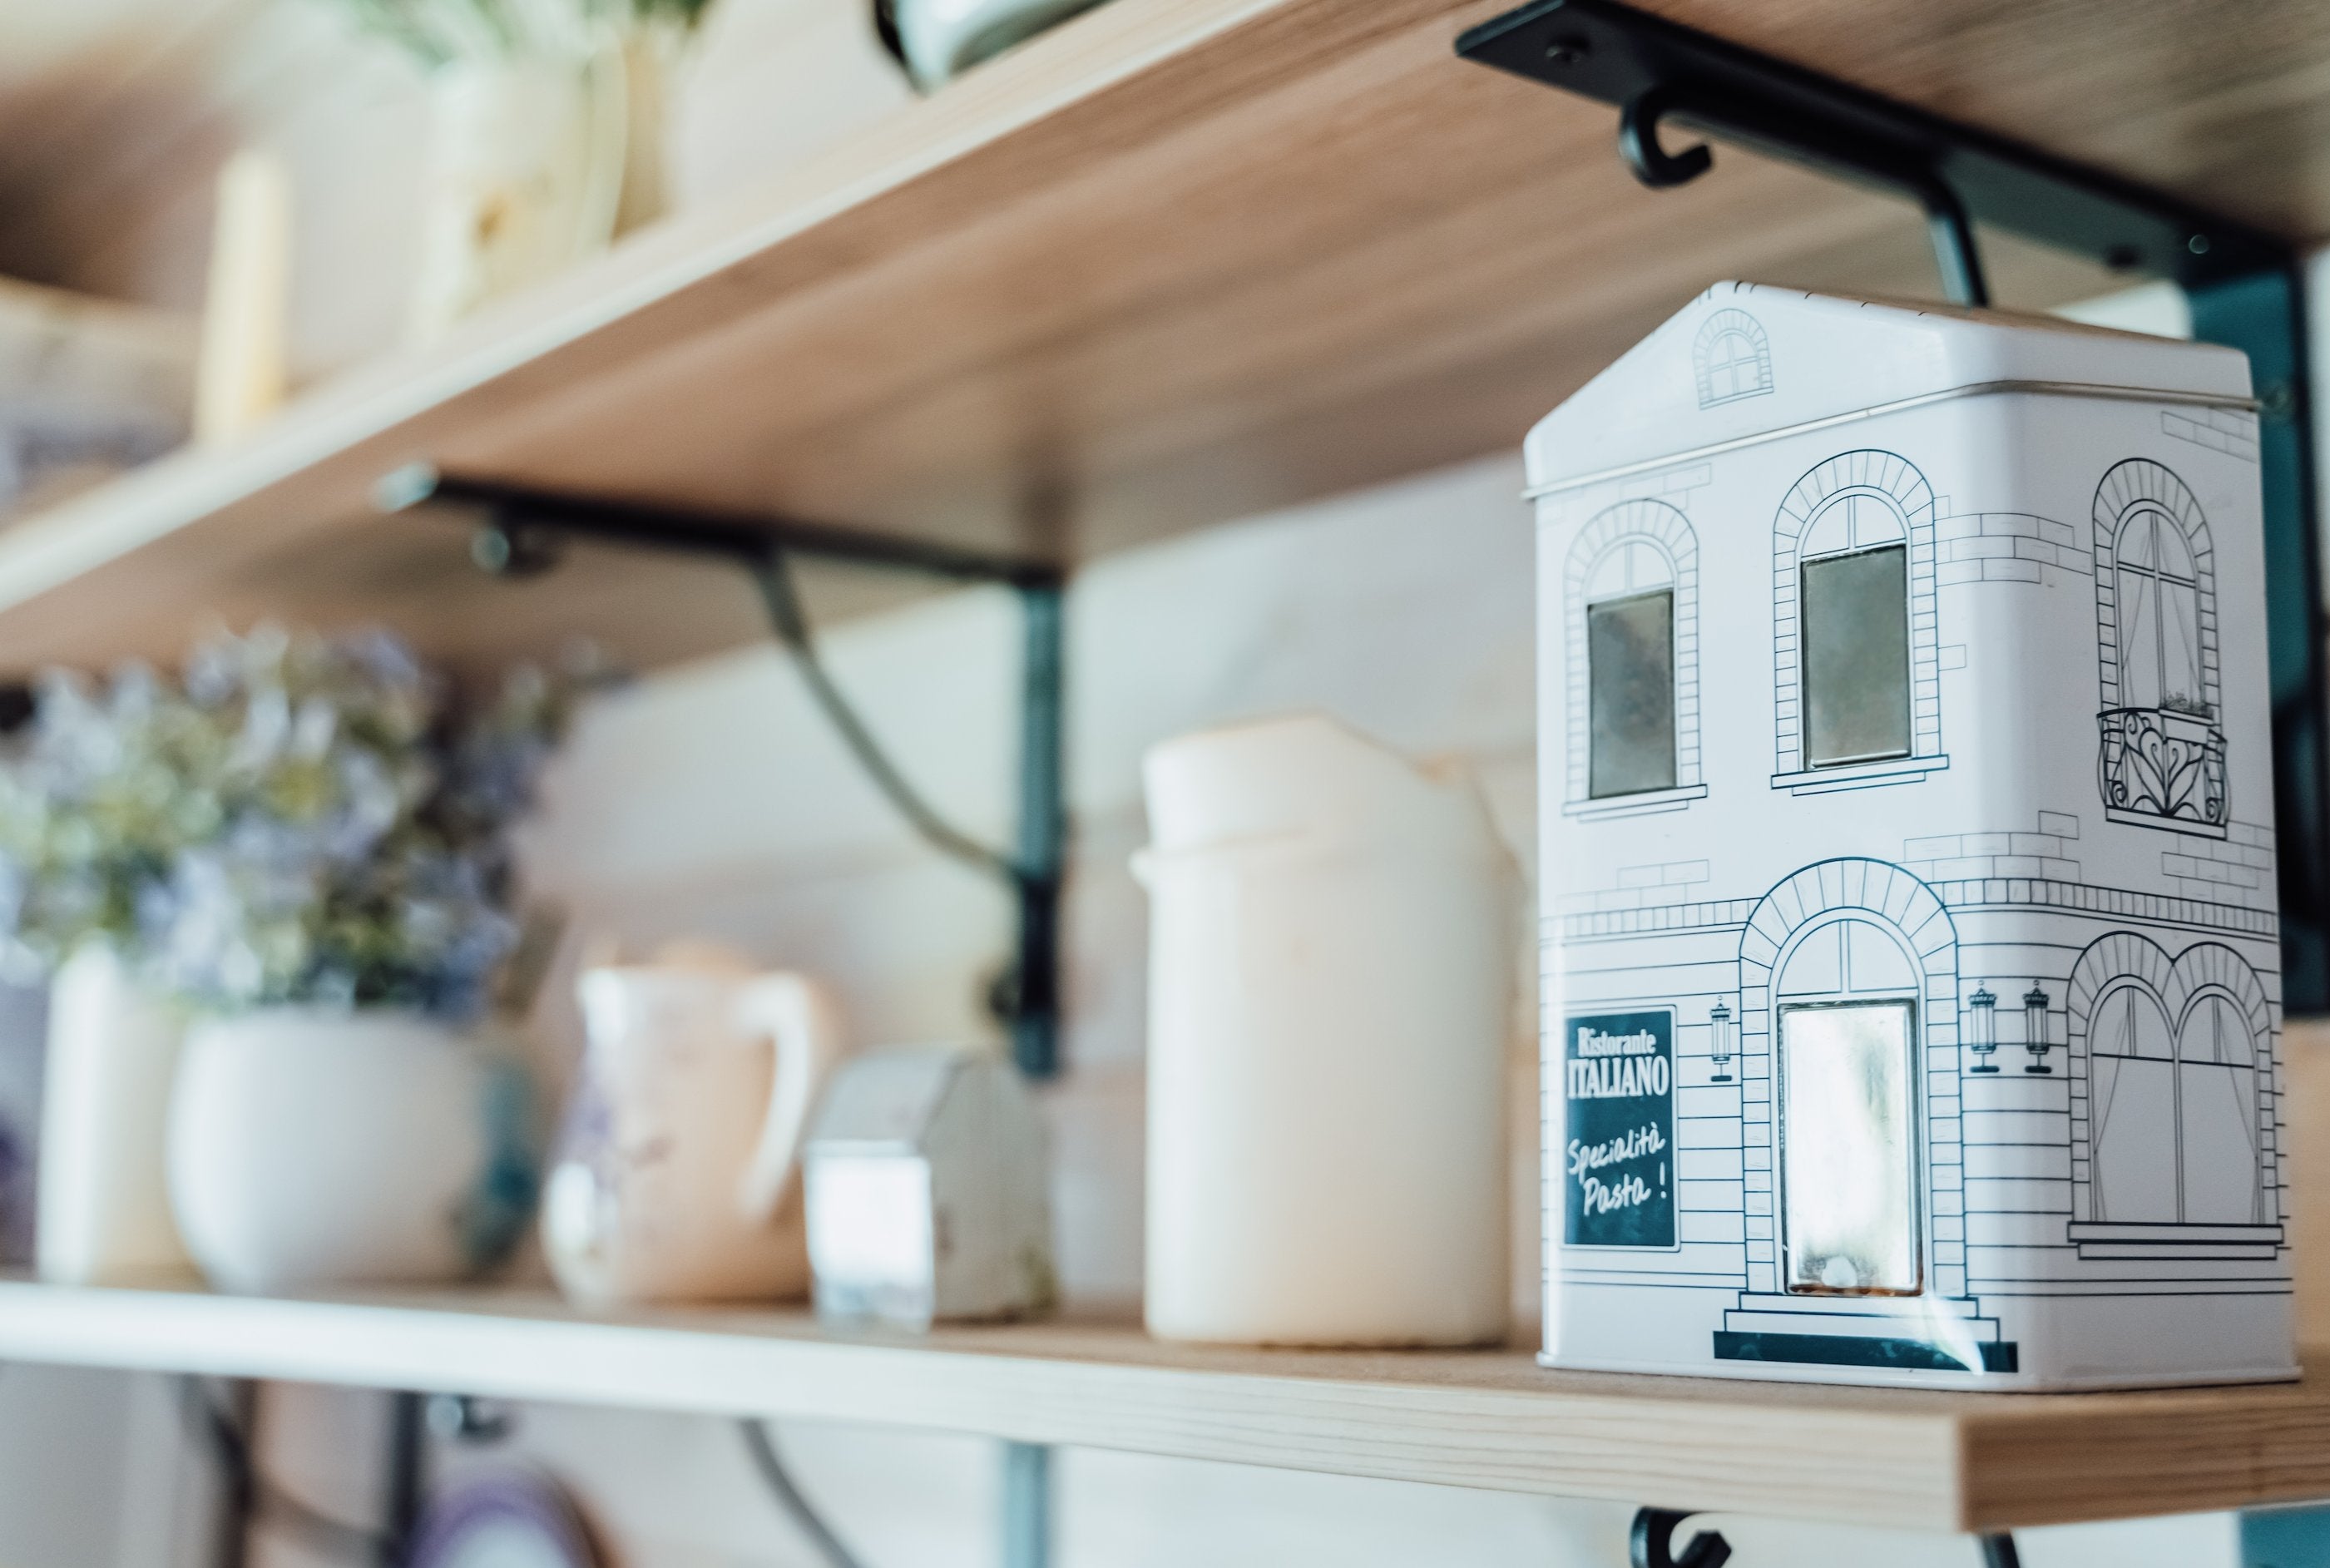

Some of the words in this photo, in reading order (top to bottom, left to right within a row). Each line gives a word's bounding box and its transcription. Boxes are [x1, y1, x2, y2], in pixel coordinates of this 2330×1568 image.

[1577, 1026, 1657, 1057] Ristorante
[1567, 1055, 1670, 1100] ITALIANO
[1568, 1121, 1666, 1185] Specialità
[1583, 1173, 1651, 1216] Pasta
